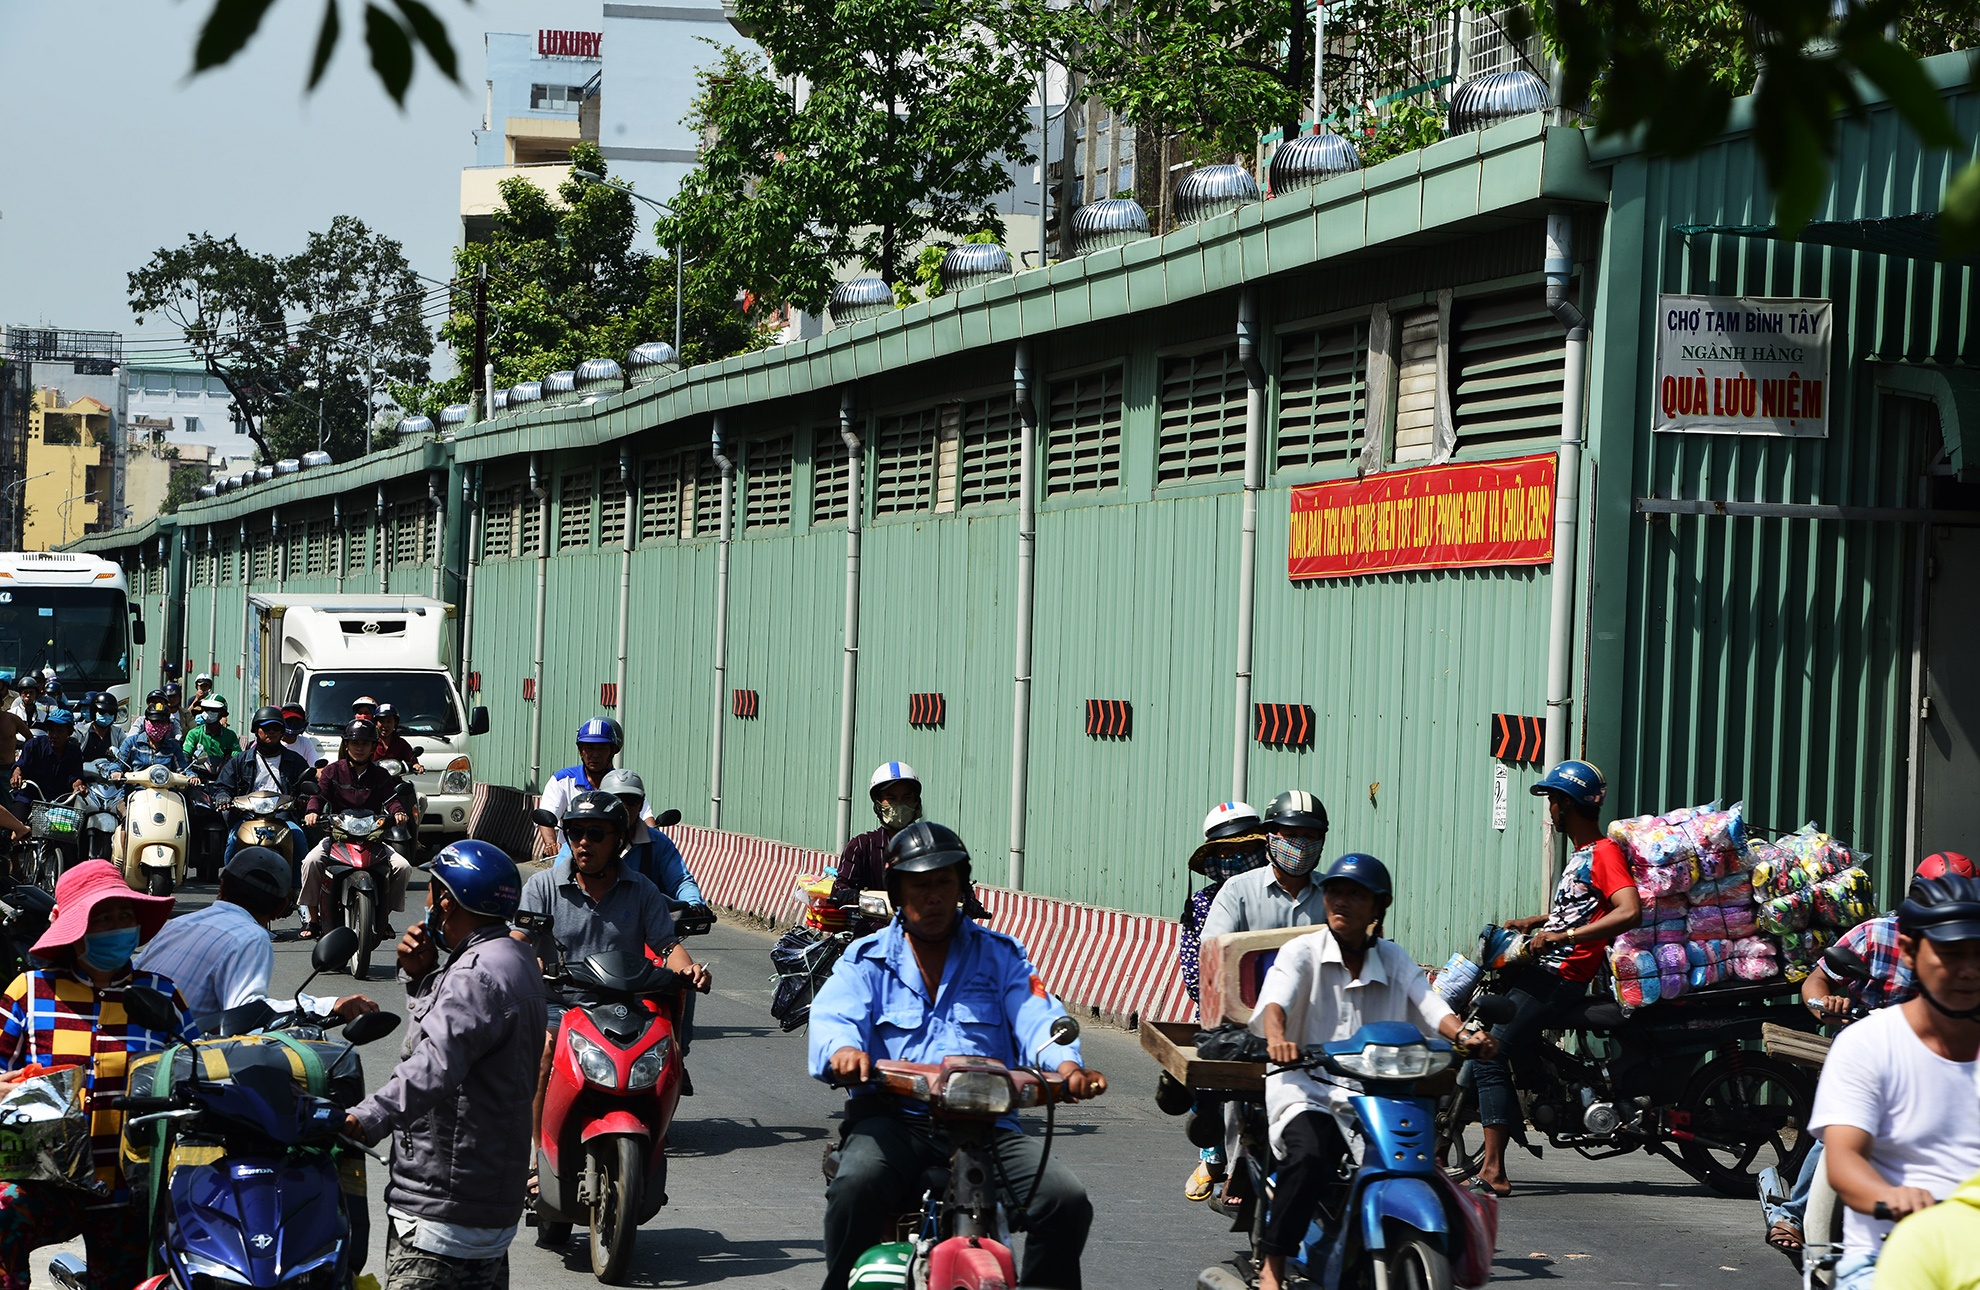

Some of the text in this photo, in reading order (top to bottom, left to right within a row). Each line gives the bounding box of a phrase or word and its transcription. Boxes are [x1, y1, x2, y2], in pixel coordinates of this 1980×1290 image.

[538, 29, 603, 57] LUXURY
[1667, 307, 1820, 336] CHỢ TẠM BÌNH TÂY
[1681, 342, 1804, 362] NGÀNH HÀNG
[1661, 367, 1823, 427] QUÀ LƯU NIỆM
[1289, 498, 1307, 560] TOÀN
[1308, 496, 1322, 558] DÂN
[1323, 495, 1339, 556] TÍCH
[1376, 487, 1396, 562] HIỆN
[1397, 477, 1413, 549] TỐT
[1413, 481, 1435, 557] LUẬT
[1435, 478, 1463, 546] PHÒNG
[1464, 475, 1487, 545] CHÁY
[1489, 474, 1499, 543] VÀ
[1501, 473, 1525, 543] CHỮA
[1526, 469, 1550, 542] CHÁY
